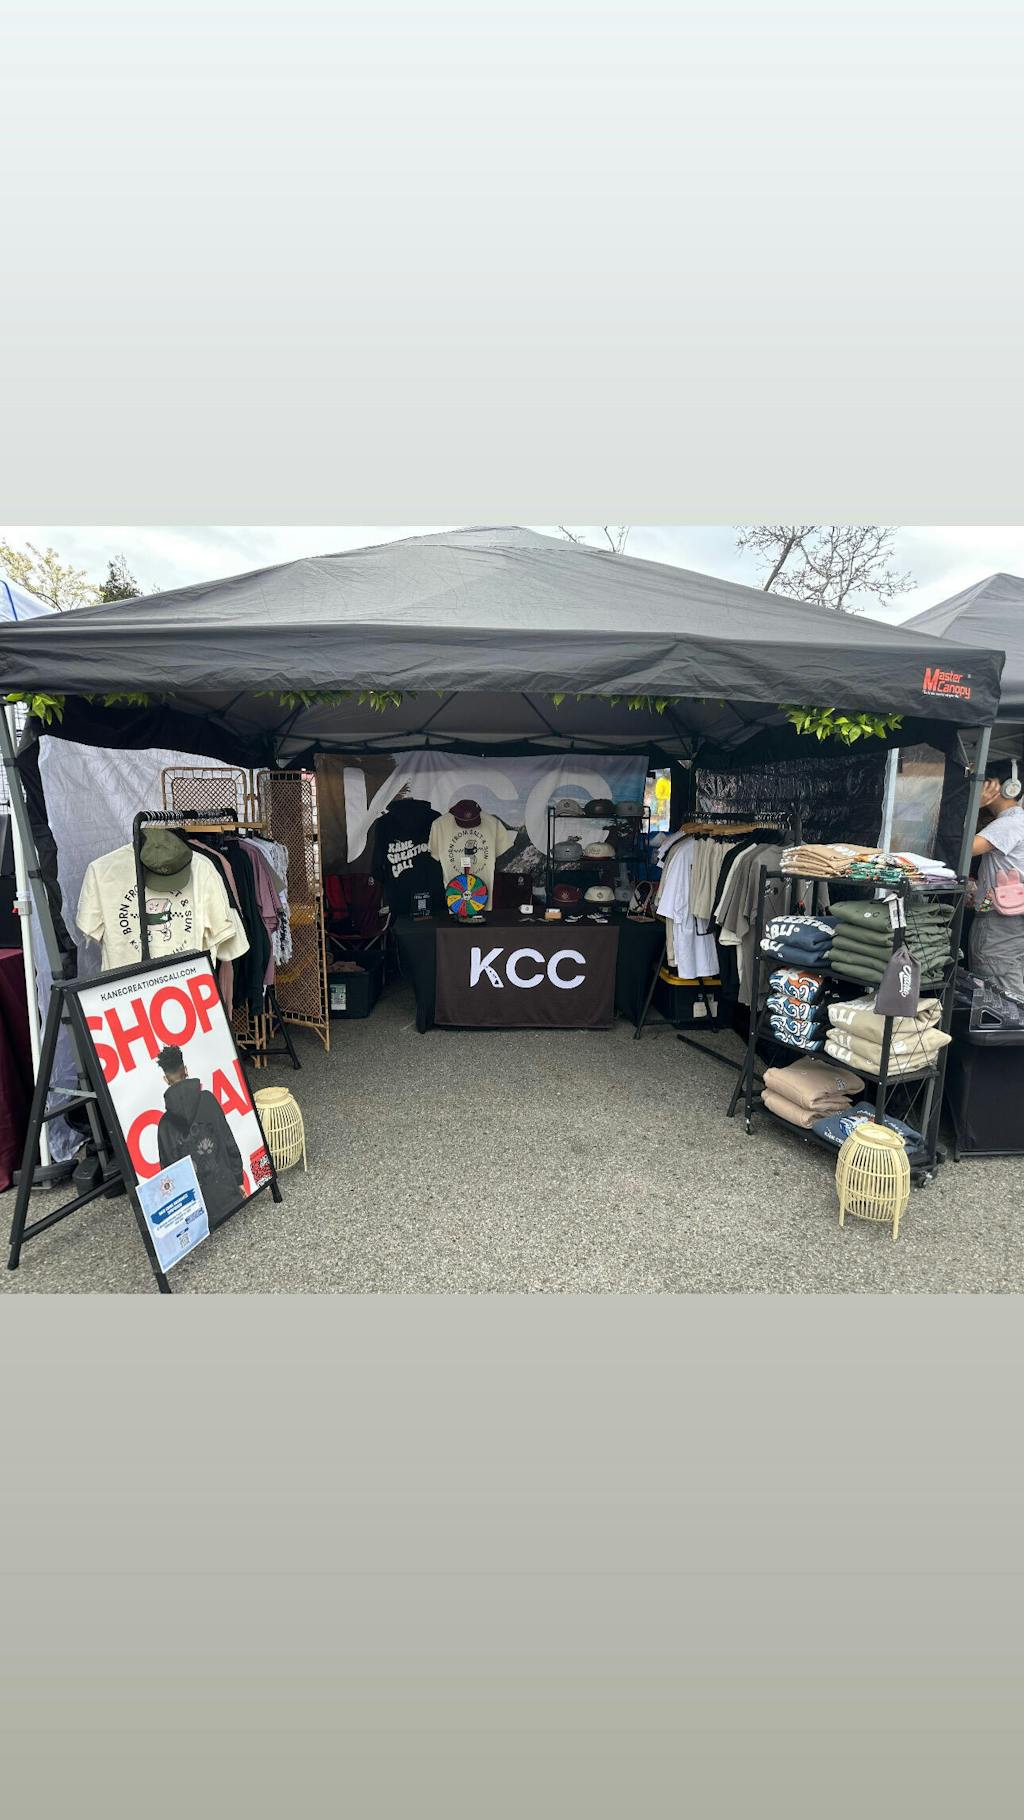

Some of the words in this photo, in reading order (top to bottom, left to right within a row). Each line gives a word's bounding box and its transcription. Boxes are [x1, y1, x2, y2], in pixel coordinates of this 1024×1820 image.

[923, 667, 963, 691] Master
[937, 681, 971, 700] Canopy
[386, 843, 432, 864] CREATIO
[119, 904, 132, 935] BORN
[184, 910, 192, 933] SUN
[469, 946, 587, 989] KCC
[100, 967, 197, 1001] KANECREATIONSCALI.COM
[86, 973, 221, 1084] SHOP
